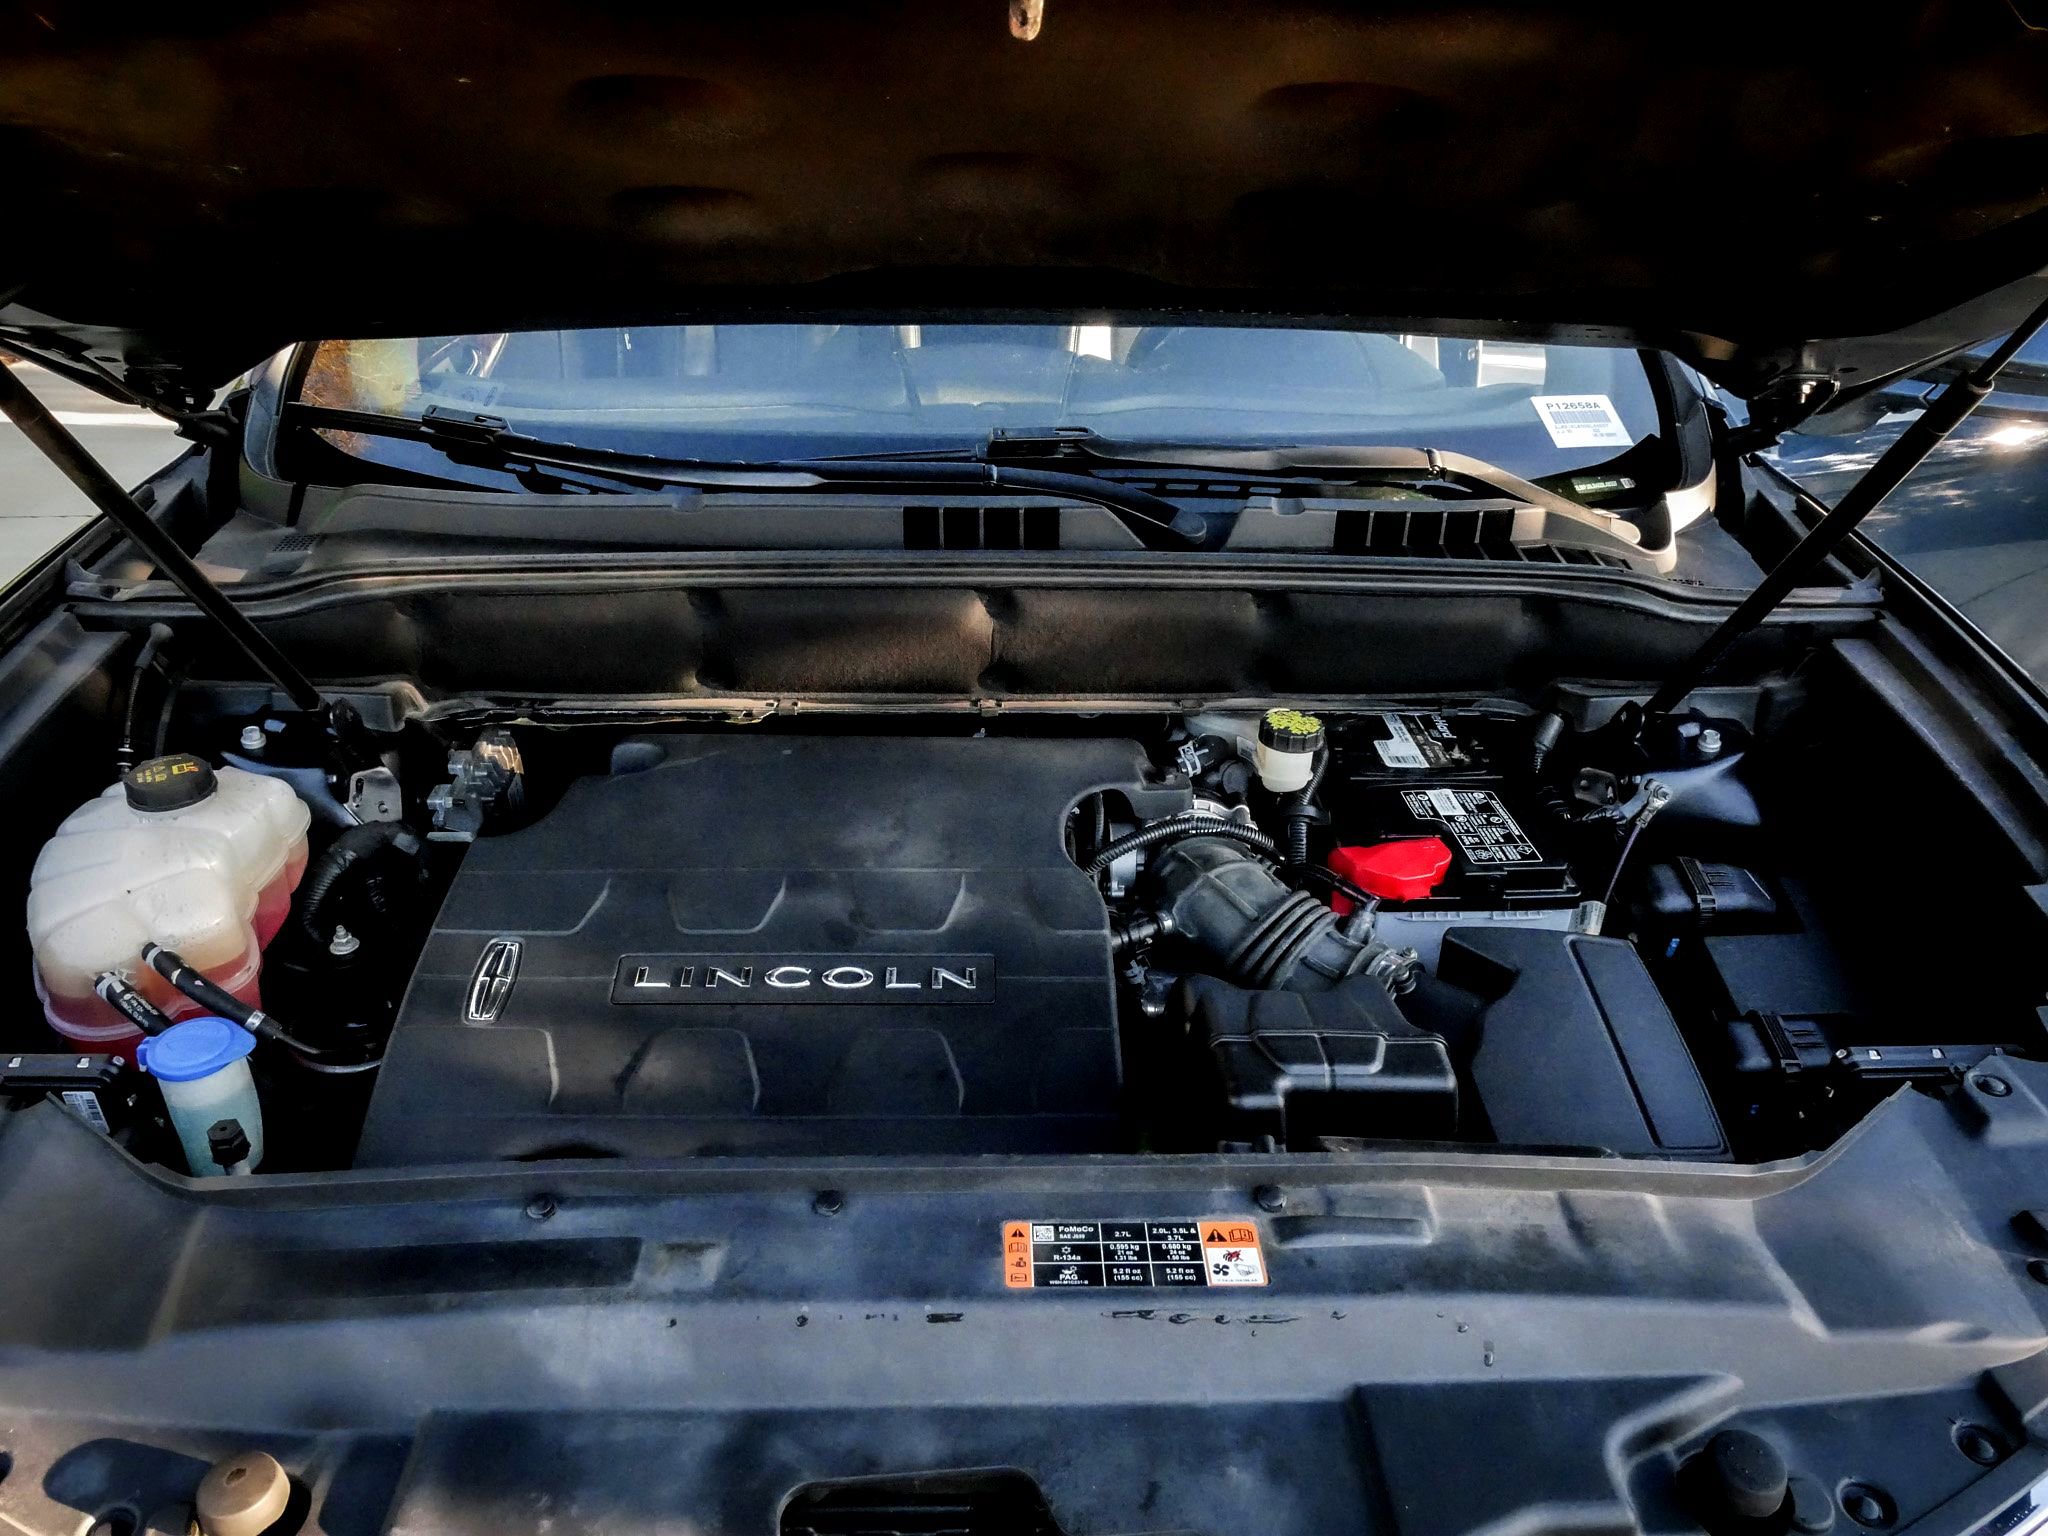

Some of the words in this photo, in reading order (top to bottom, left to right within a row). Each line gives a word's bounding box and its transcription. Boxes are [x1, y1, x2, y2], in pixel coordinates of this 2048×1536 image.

[1546, 402, 1601, 410] P12658A
[634, 966, 977, 989] LINCOLN
[1130, 1243, 1140, 1251] kg
[1181, 1243, 1192, 1251] kg
[1114, 1274, 1130, 1282] (155
[1130, 1274, 1143, 1282] cc)
[1167, 1274, 1184, 1282] (155
[1184, 1274, 1197, 1282] cc)
